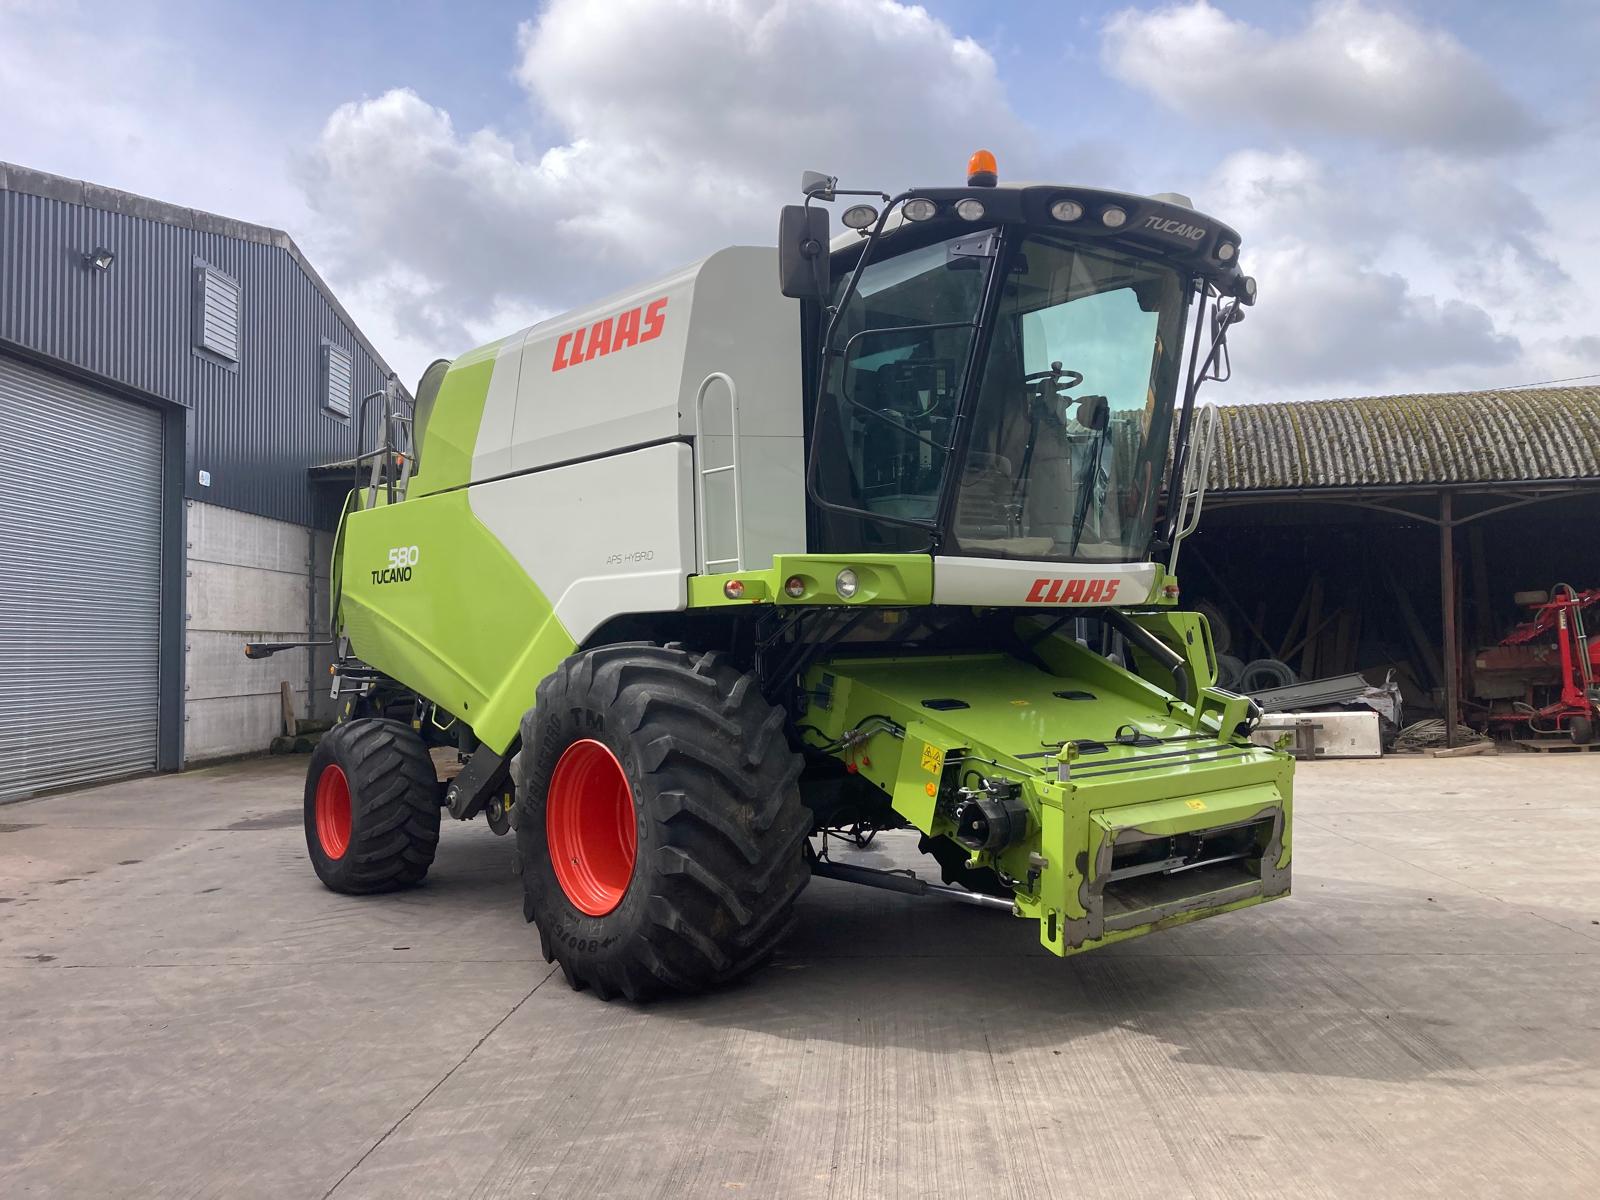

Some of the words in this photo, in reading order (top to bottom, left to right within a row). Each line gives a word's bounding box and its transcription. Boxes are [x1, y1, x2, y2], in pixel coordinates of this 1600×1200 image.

[1144, 215, 1206, 241] TUCANO
[551, 296, 669, 373] CLAAS
[388, 545, 419, 569] 580
[606, 554, 622, 565] APS
[624, 550, 654, 563] HYBRID
[371, 566, 412, 585] TUCANO
[1024, 579, 1121, 603] CLAAS
